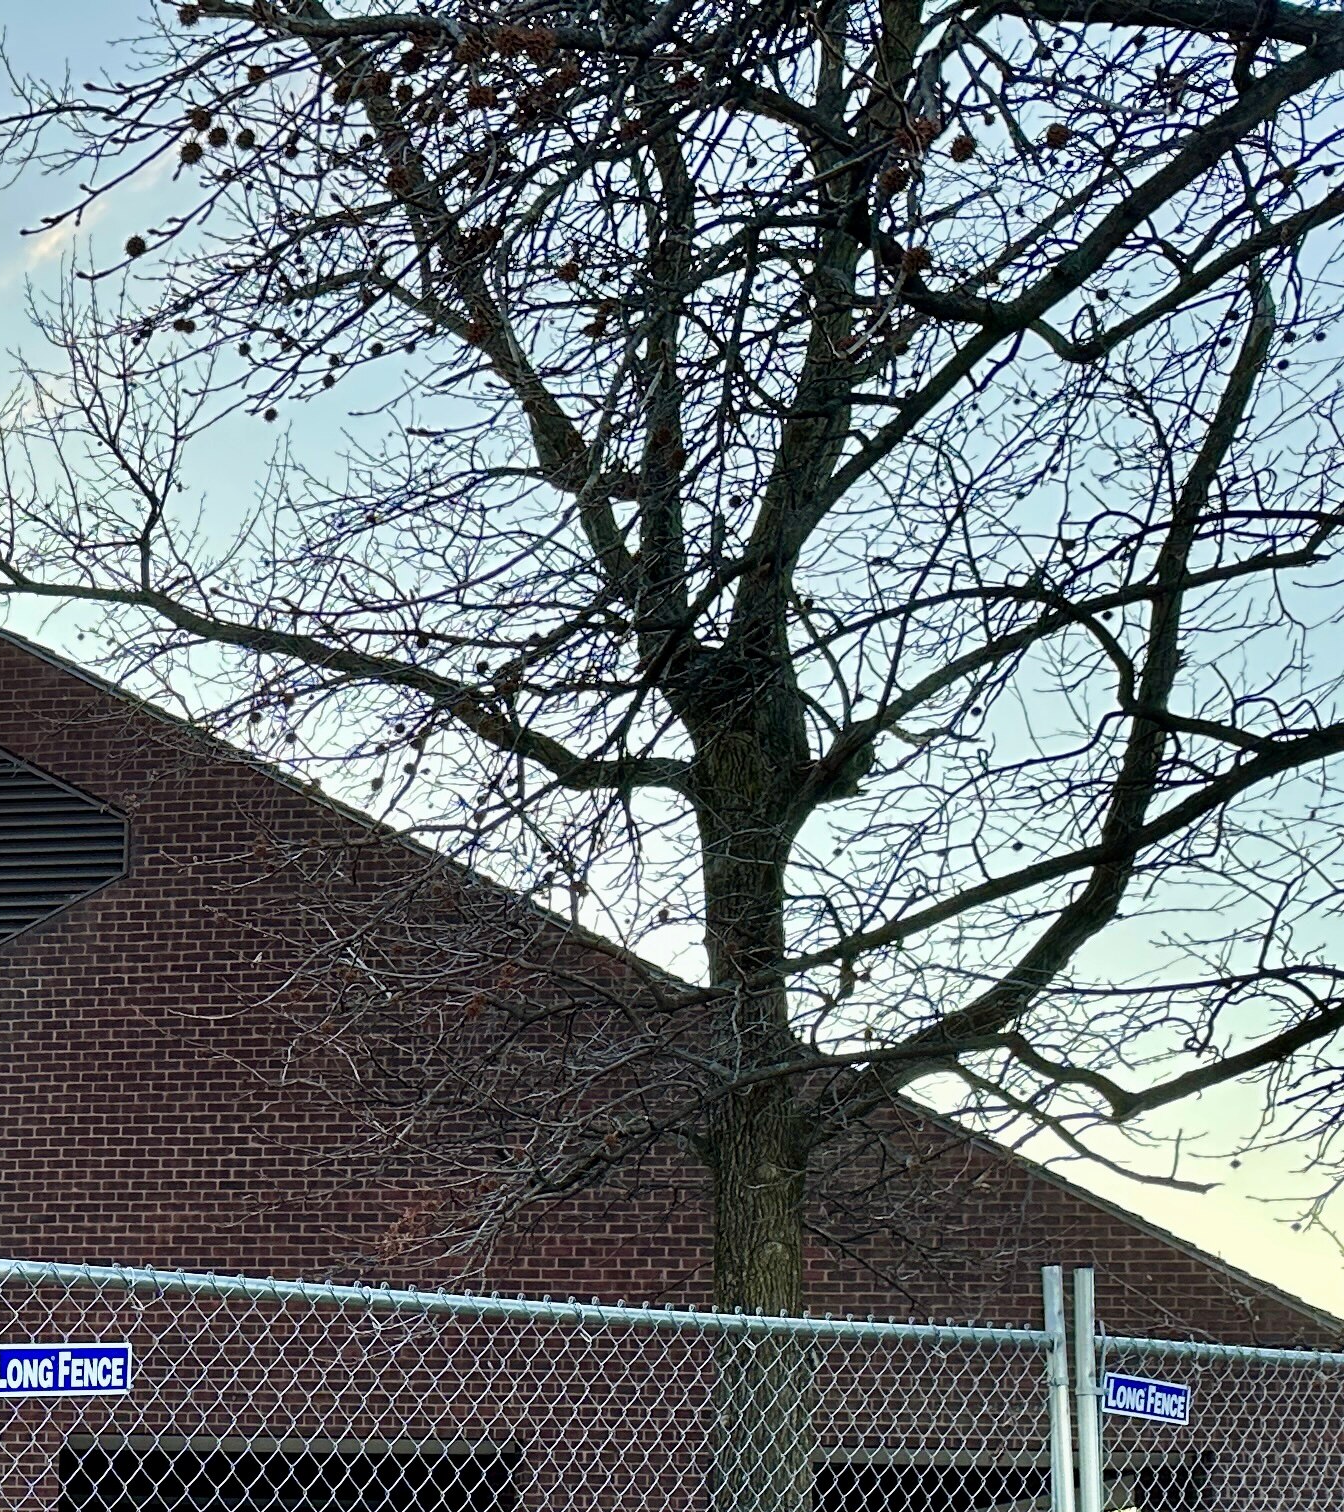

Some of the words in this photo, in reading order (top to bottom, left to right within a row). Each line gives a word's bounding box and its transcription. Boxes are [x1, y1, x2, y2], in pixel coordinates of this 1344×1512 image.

[58, 1351, 125, 1388] FENCE
[1107, 1378, 1146, 1412] LONG
[1146, 1385, 1186, 1419] FENCE
